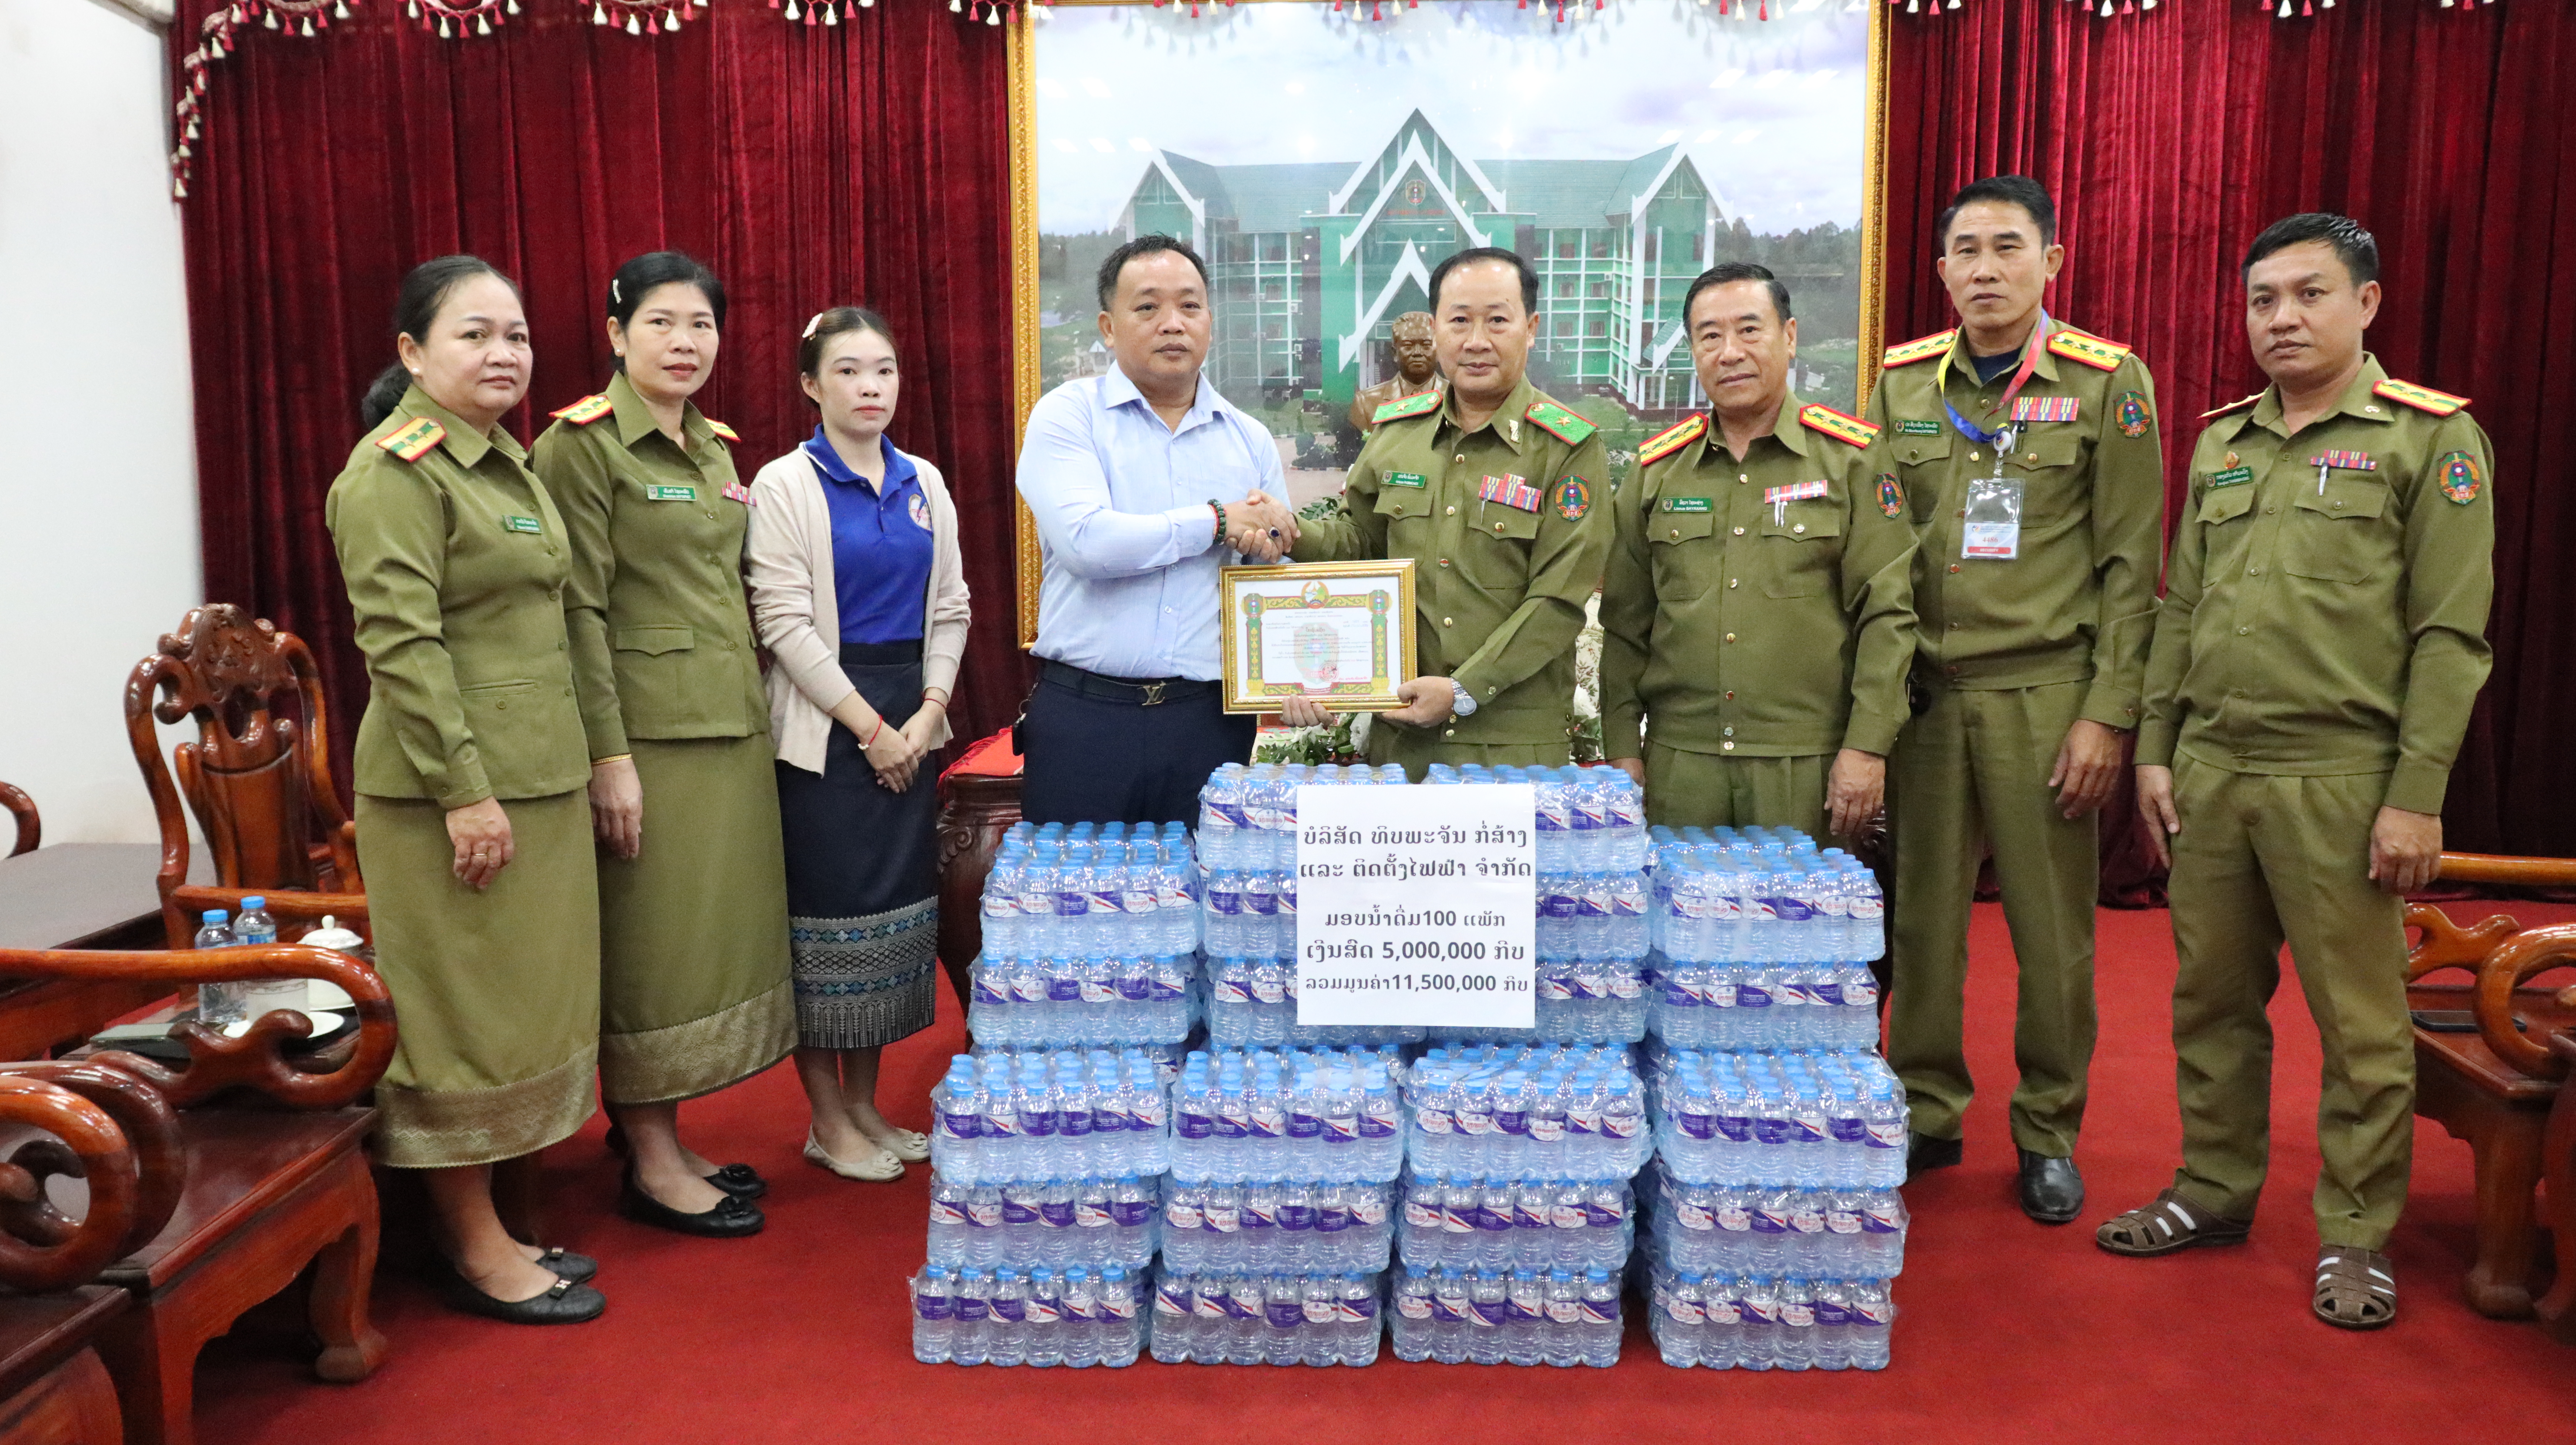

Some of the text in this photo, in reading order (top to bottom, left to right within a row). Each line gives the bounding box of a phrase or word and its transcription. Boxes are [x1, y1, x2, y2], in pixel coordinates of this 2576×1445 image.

[1305, 821, 1527, 847] ບໍລິສັດ ທິບພະຈັນ ກໍ່ສ້າງ
[1301, 854, 1531, 881] ແລະ ຕິດຕັ້ງໄຟຟ້າ ຈຳກັດ
[1464, 911, 1505, 926] ແພັກ
[1383, 941, 1485, 962] 5,000,000
[1495, 941, 1524, 959] ກີບ
[1504, 976, 1527, 991] ກີບ
